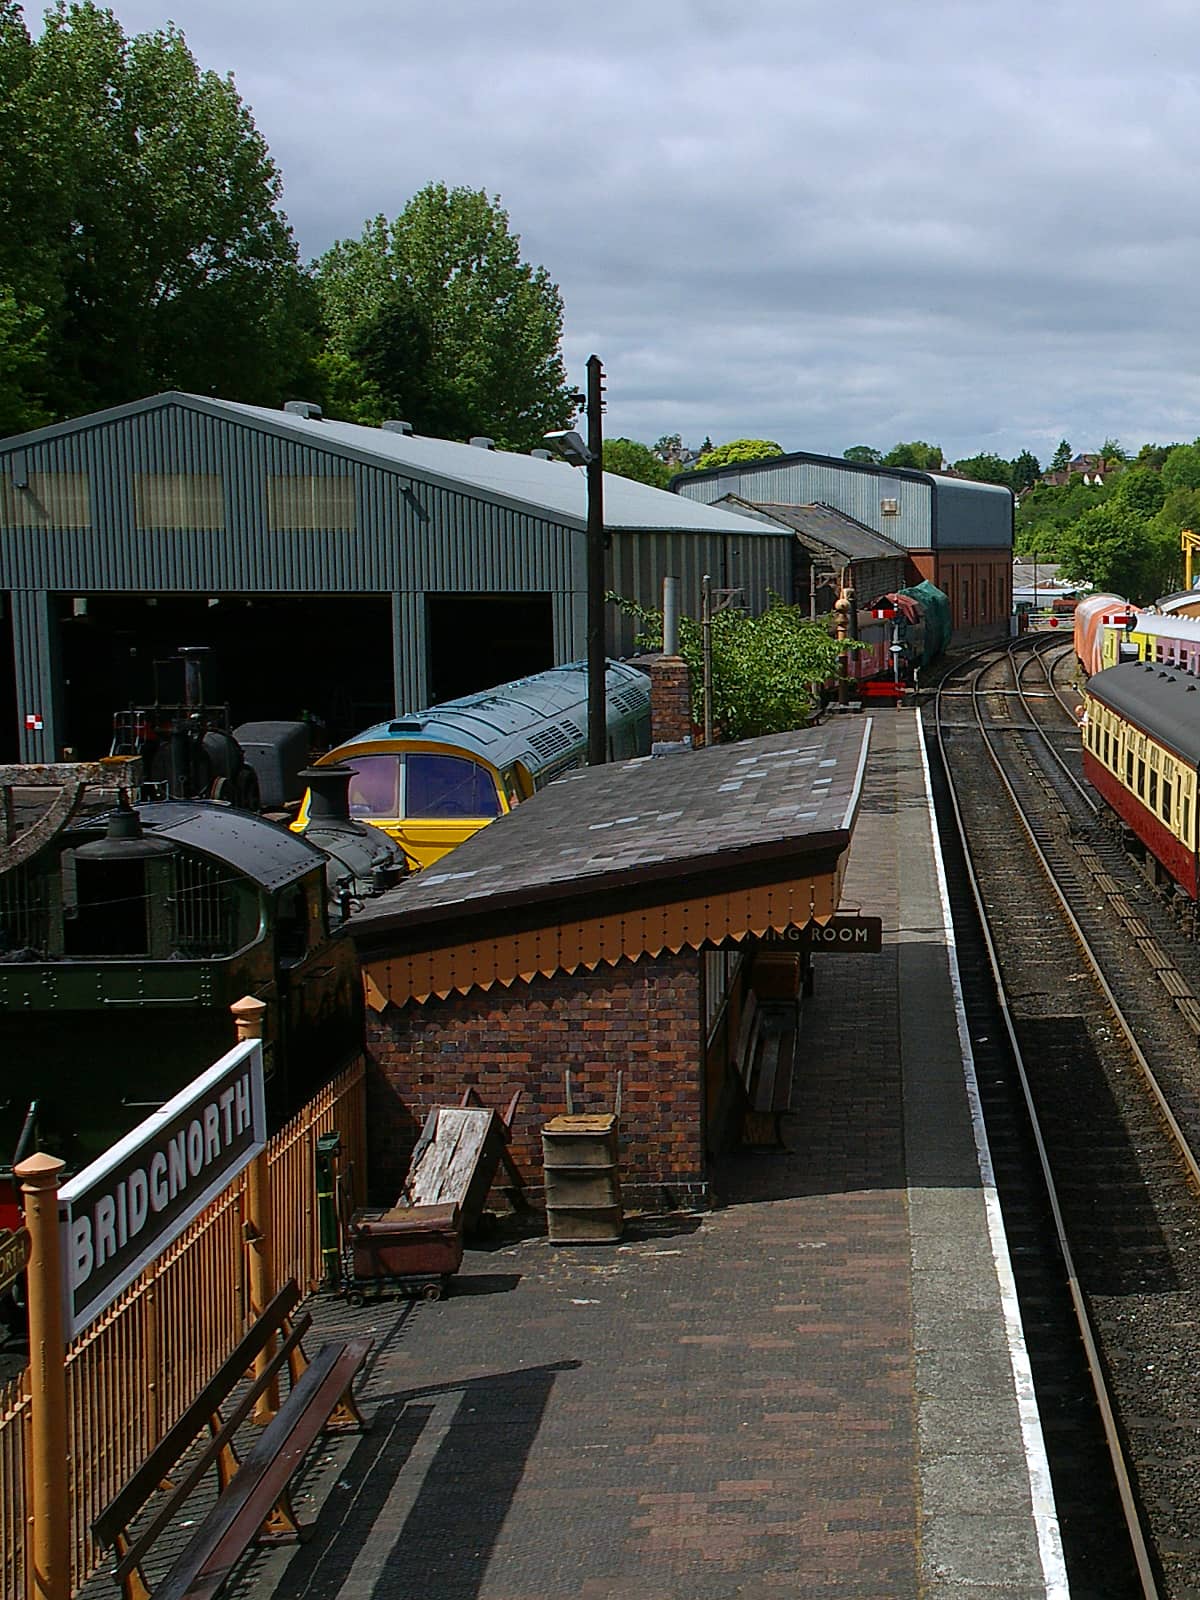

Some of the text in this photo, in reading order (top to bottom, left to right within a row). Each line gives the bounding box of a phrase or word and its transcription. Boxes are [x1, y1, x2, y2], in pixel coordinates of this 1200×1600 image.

[811, 927, 869, 942] ROOM
[72, 1073, 251, 1290] BRIDGNORTH
[0, 1239, 25, 1278] ORTH
